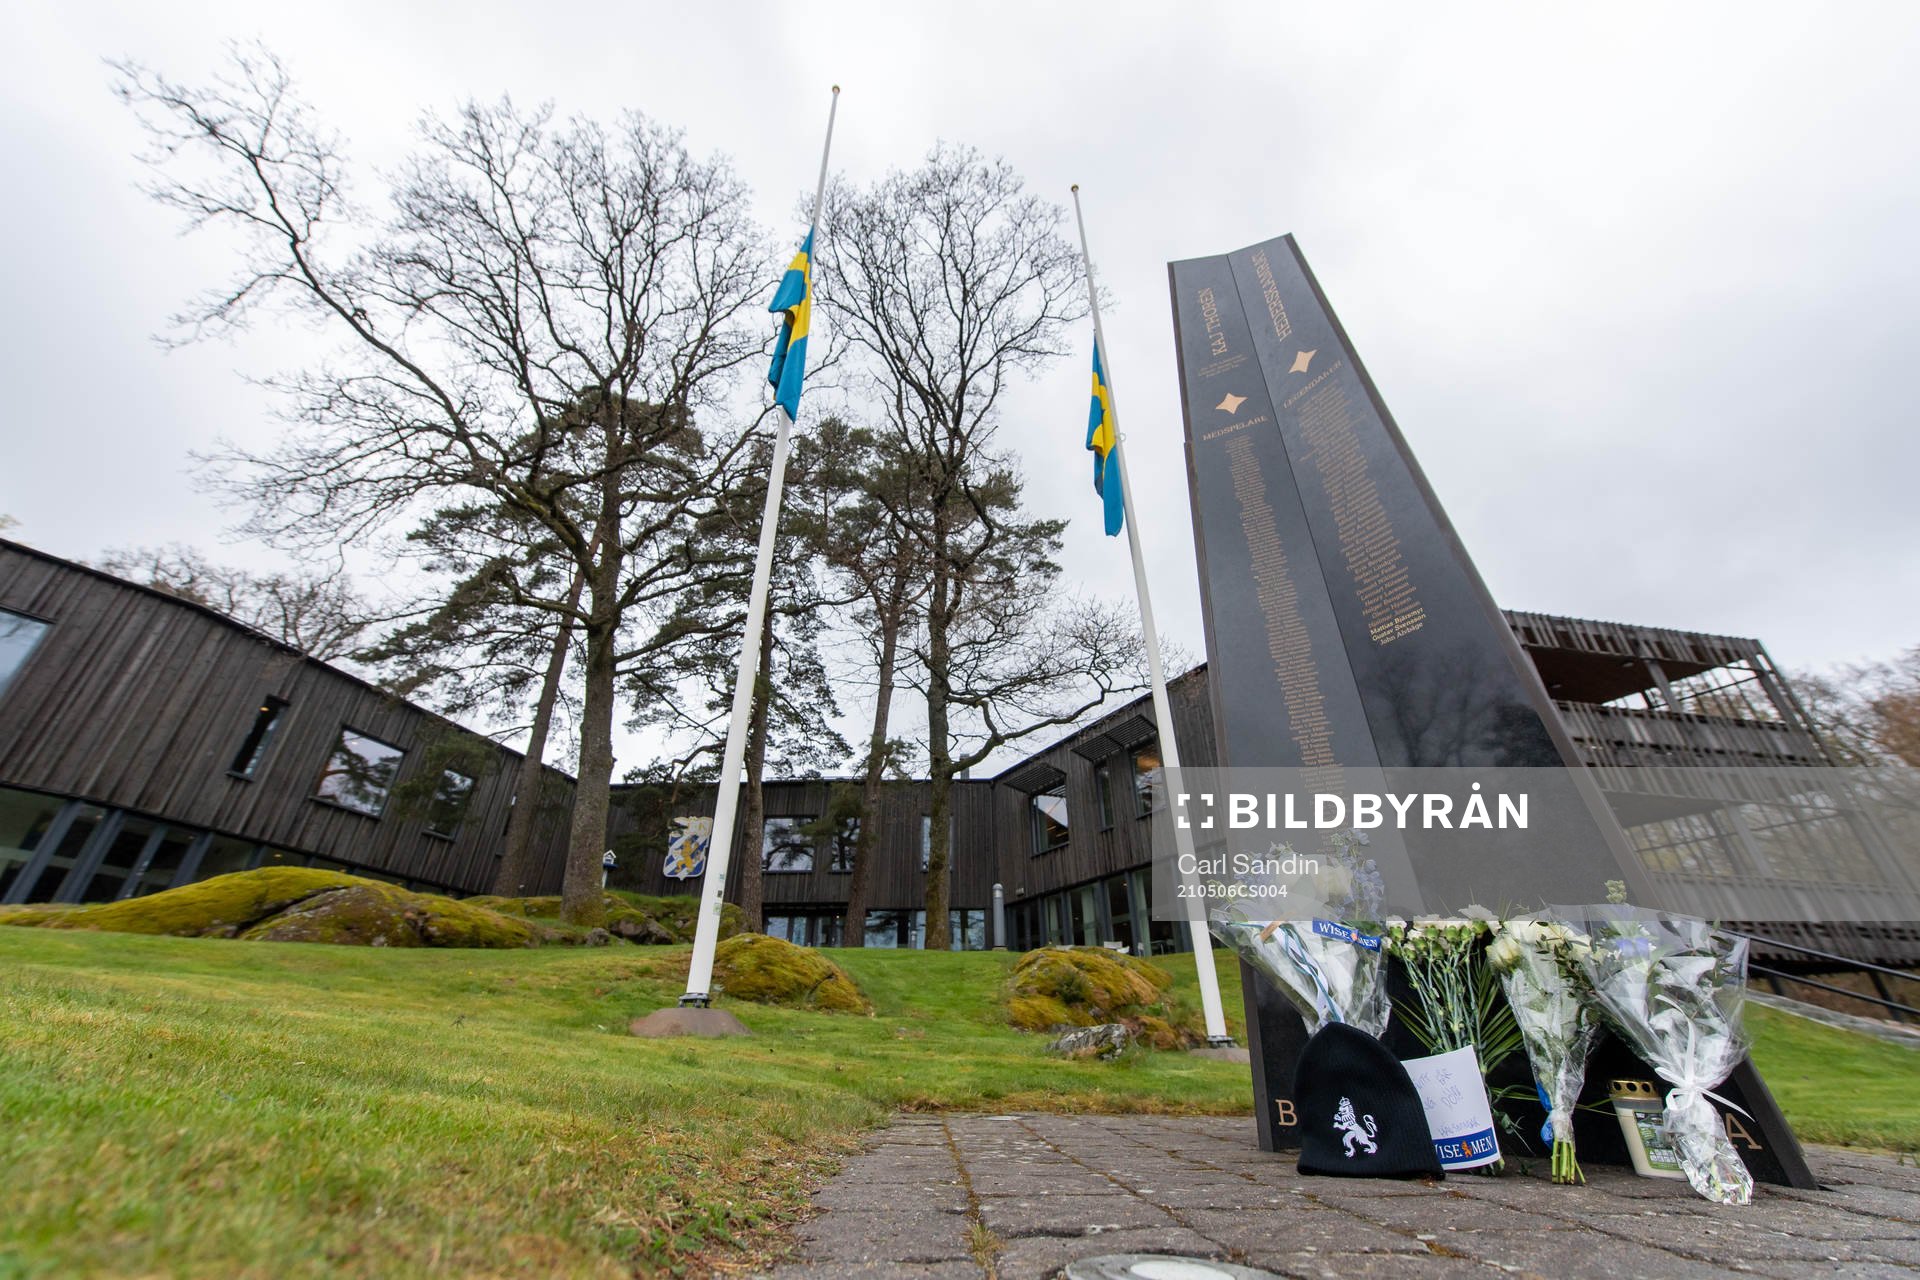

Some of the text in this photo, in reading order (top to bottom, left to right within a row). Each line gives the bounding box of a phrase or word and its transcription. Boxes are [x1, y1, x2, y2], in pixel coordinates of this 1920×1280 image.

[1209, 332, 1228, 356] KAJ
[1372, 613, 1426, 641] Gustav Svensson
[1380, 635, 1396, 646] John
[1319, 922, 1352, 940] WISE
[1471, 1136, 1493, 1155] MEN
